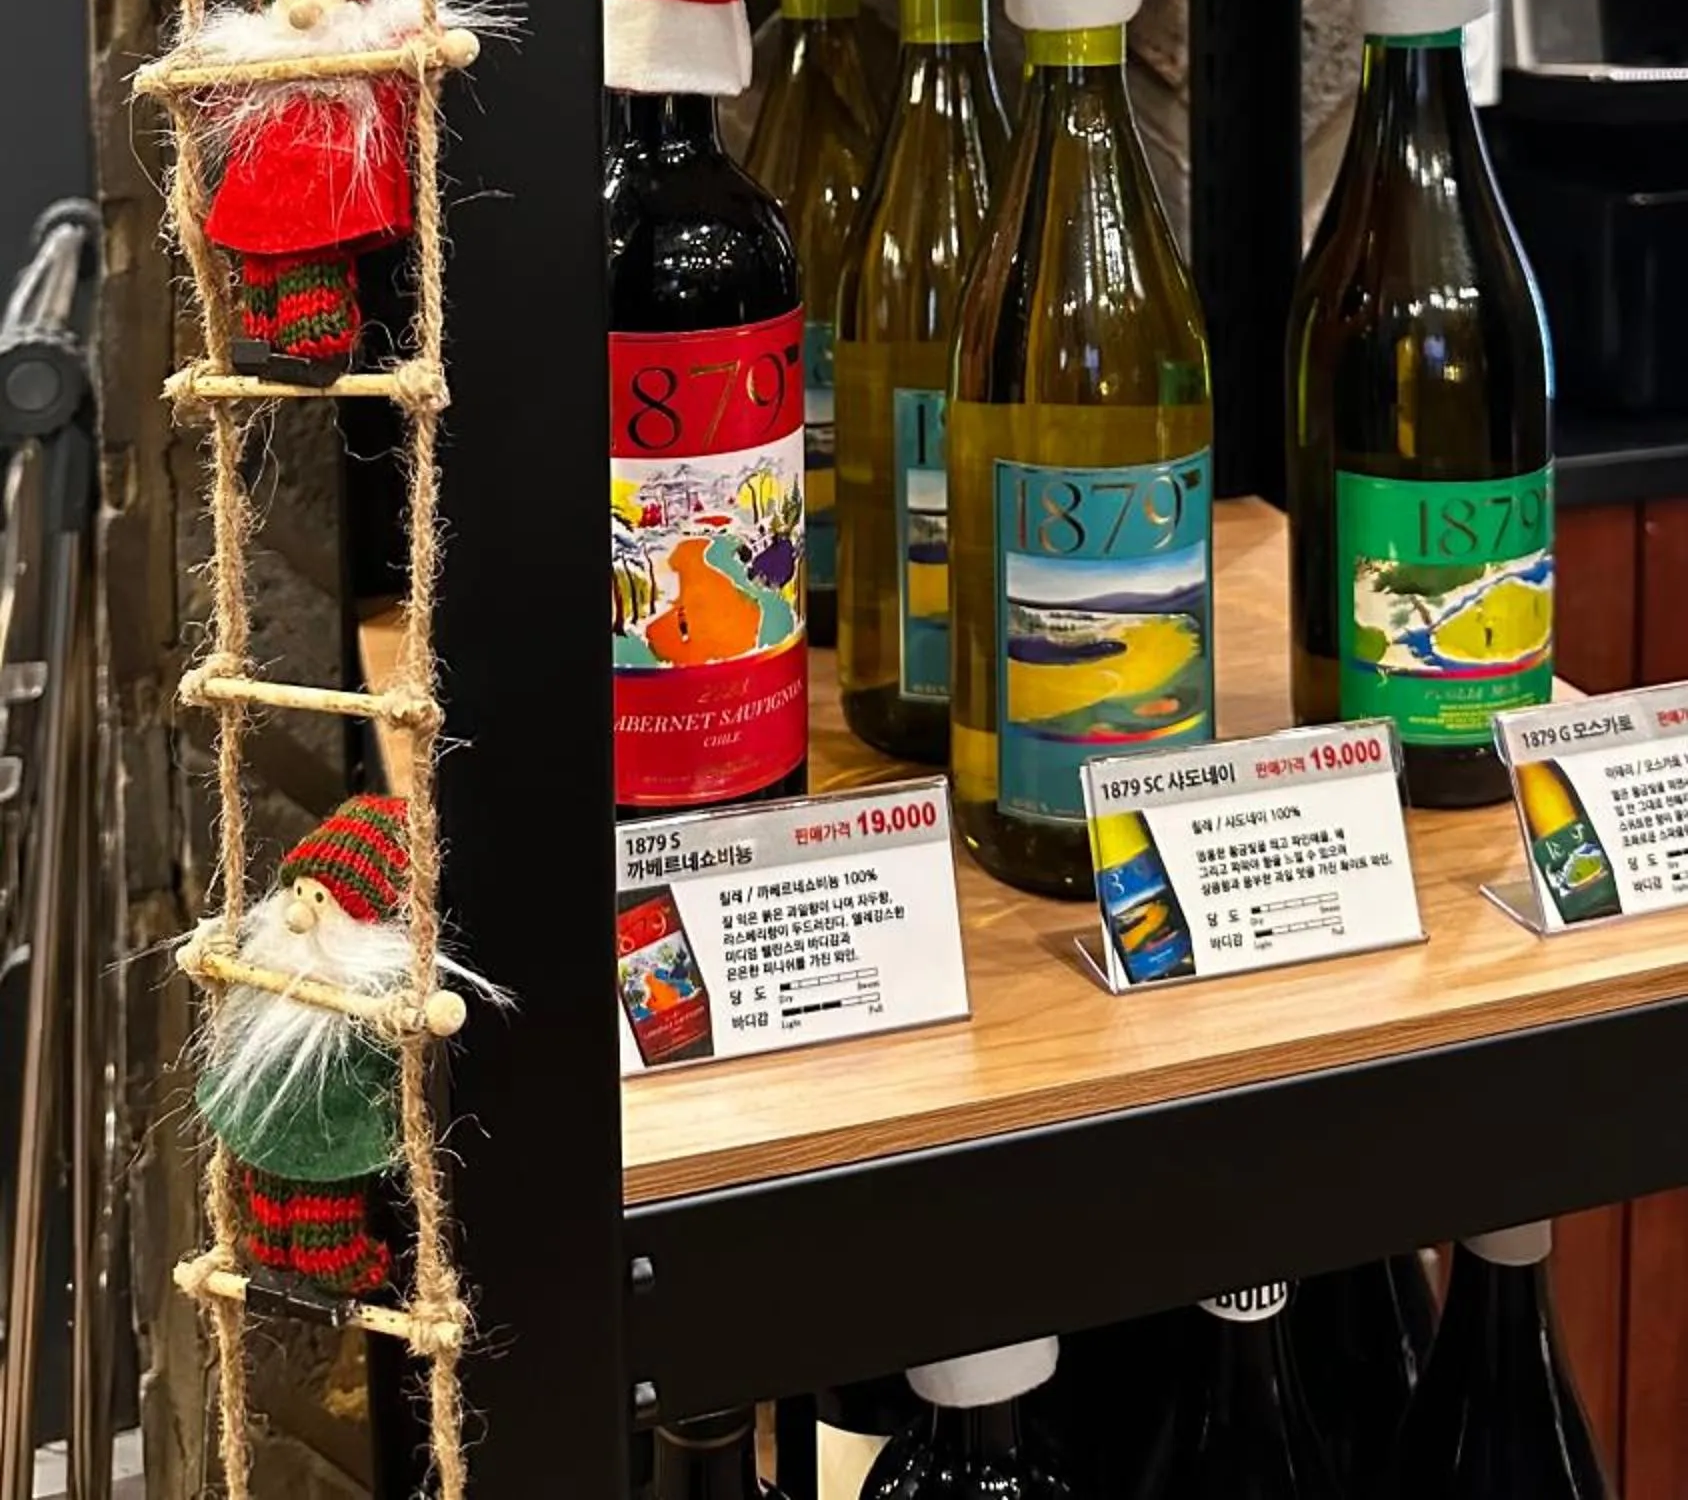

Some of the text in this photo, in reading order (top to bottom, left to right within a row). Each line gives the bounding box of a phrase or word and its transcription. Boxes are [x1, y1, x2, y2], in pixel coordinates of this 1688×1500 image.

[627, 352, 785, 450] 879
[1018, 475, 1183, 555] 1879
[1419, 489, 1545, 558] 1879
[1521, 728, 1557, 749] 1879
[1559, 724, 1571, 742] G
[1574, 715, 1634, 740] 모스카토
[1101, 738, 1382, 801] 1879 SC 샤도네이 판매가격 19,000
[625, 802, 936, 856] 1879 S 판매가격 19,000
[1271, 806, 1301, 821] 100%
[627, 844, 753, 880] 까베르네쇼비뇽
[844, 868, 879, 886] 100%
[730, 986, 767, 1006] 당 도
[732, 1011, 769, 1030] 바디감
